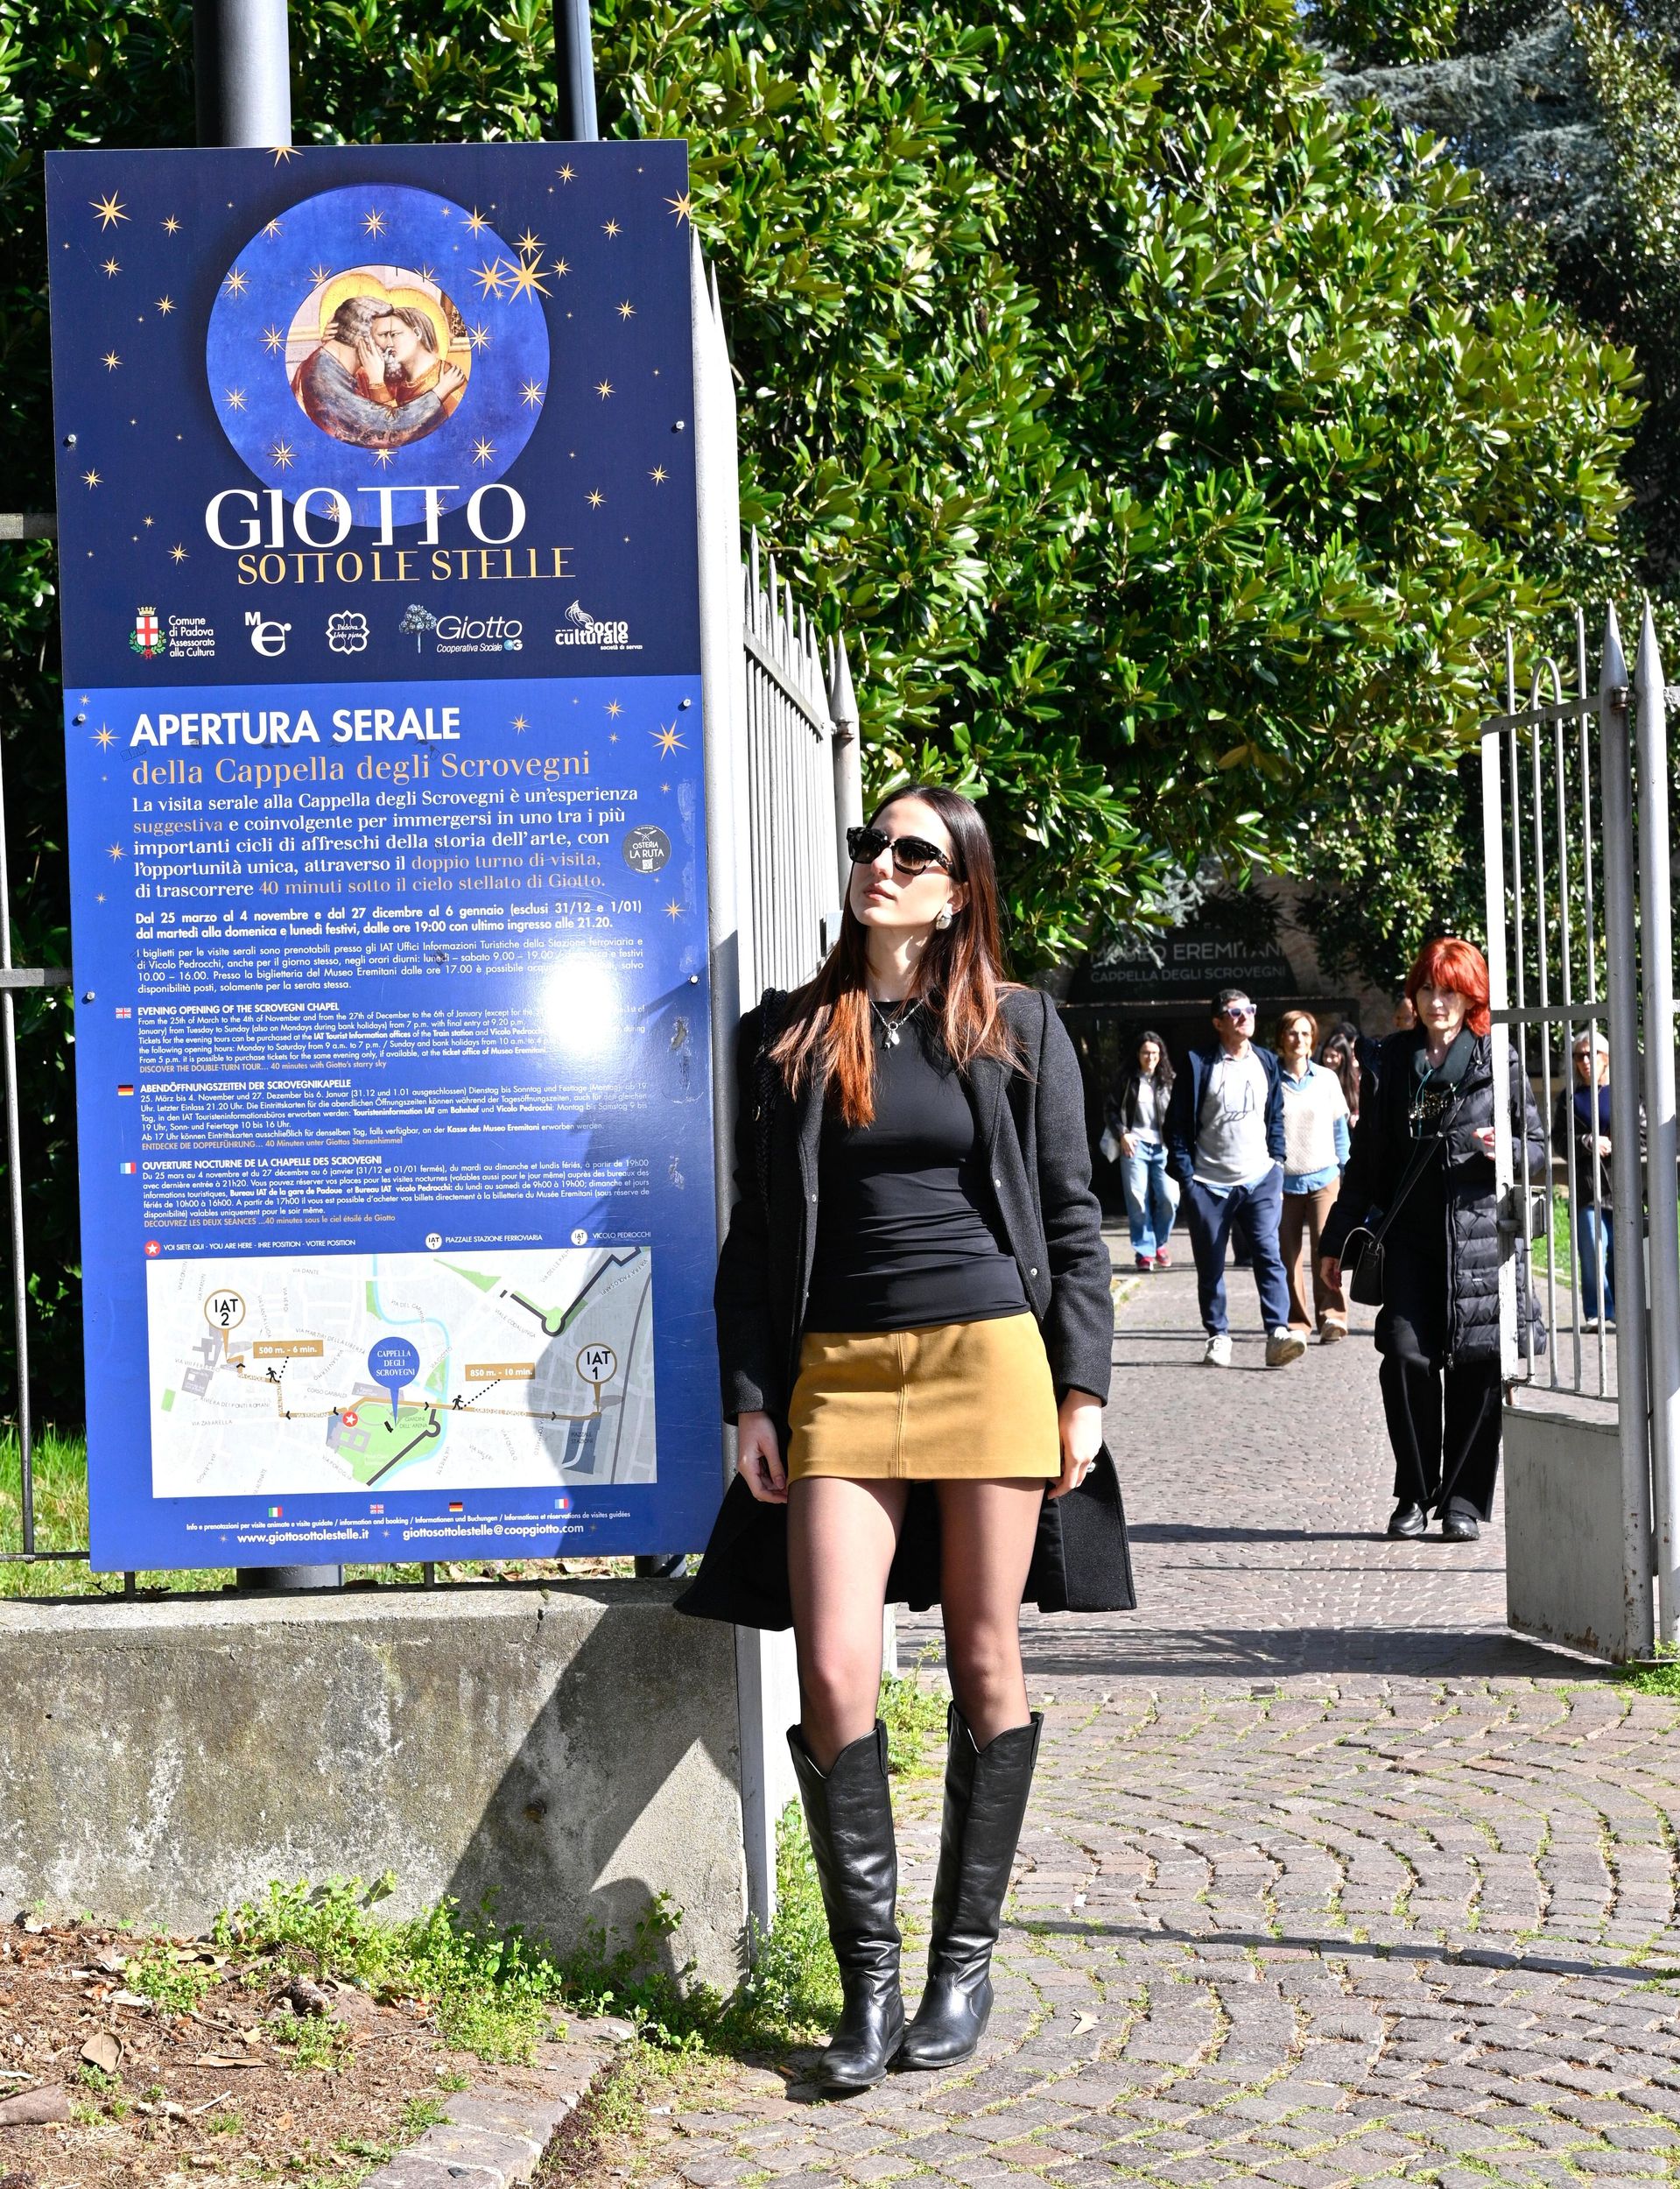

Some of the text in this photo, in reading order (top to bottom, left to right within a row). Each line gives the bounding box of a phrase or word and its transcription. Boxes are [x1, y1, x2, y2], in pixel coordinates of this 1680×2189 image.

[205, 483, 526, 550] GIOTTO
[237, 547, 576, 585] SOTTO LE STELLE
[168, 615, 206, 626] Comune
[436, 616, 523, 639] Giotto
[584, 621, 628, 634] socio
[169, 624, 214, 637] di Padova
[555, 628, 628, 645] culturale
[169, 637, 215, 647] Assessorato
[437, 643, 478, 654] Cooperativa
[479, 642, 503, 651] Sociale
[169, 646, 215, 658] alla Cultura
[130, 707, 460, 747] APERTURA SERALE
[132, 750, 589, 788] della Cappella degli Scrovegni
[133, 798, 152, 813] La
[158, 797, 202, 811] visita
[208, 795, 258, 810] serale
[264, 794, 292, 809] alla
[299, 792, 369, 811] Cappella
[376, 791, 416, 809] degli
[422, 789, 504, 807] Scrovegni
[510, 789, 520, 802] è
[134, 807, 625, 836] suggestiva e coinvolgente per immergersi in uno tra i più
[134, 839, 229, 858] importanti
[236, 838, 272, 853] cicli
[279, 837, 294, 851] di
[301, 835, 379, 851] affreschi
[386, 834, 427, 848] della
[434, 833, 485, 848] storia
[578, 833, 608, 844] con
[632, 841, 659, 849] OSTERIA
[629, 848, 664, 859] LA RUTA
[134, 853, 601, 880] l'opportunità unica, attraverso il doppio turno di visita,
[136, 874, 605, 897] di trascorrere 40 minuti sotto il cielo stellato di Giotto.
[136, 911, 154, 924] Dal
[160, 912, 175, 923] 25
[182, 914, 217, 923] marzo
[223, 910, 234, 922] al
[240, 911, 248, 921] 4
[254, 908, 308, 921] novembre
[327, 907, 345, 919] dal
[351, 907, 366, 919] 27
[372, 905, 423, 919] dicembre
[429, 904, 439, 917] al
[446, 905, 453, 917] 6
[460, 904, 504, 919] gennaio
[510, 902, 548, 917] (esclusi
[555, 901, 591, 915] 31/12
[597, 904, 605, 912] e
[611, 900, 642, 914] 1/01)
[136, 926, 153, 940] dal
[157, 926, 198, 939] martedì
[201, 926, 221, 938] alla
[224, 925, 277, 937] domenica
[290, 923, 322, 935] lunedì
[326, 922, 360, 935] festivi,
[363, 921, 390, 934] dalle
[392, 925, 411, 933] ore
[415, 920, 446, 932] 19:00
[471, 919, 504, 931] ultimo
[508, 919, 552, 933] ingresso
[555, 917, 574, 928] alle
[578, 917, 613, 928] 21.20.
[1091, 965, 1286, 983] CAPPELLA DEGLI SCROVEGNI
[137, 1006, 177, 1016] EVENING
[179, 1005, 220, 1015] OPENING
[236, 1004, 252, 1013] THE
[255, 1003, 305, 1012] SCROVEGNI
[307, 1003, 340, 1011] CHAPEL
[140, 1079, 351, 1093] ABENDÖFFNUNGSZEITEN DER SCROVEGNIKAPELLE
[142, 1160, 193, 1170] OUVERTURE
[194, 1159, 243, 1169] NOCTURNE
[257, 1158, 269, 1167] LA
[271, 1158, 311, 1167] CHAPELLE
[313, 1157, 329, 1165] DES
[331, 1156, 382, 1165] SCROVEGNI
[214, 1299, 238, 1313] IAT
[221, 1312, 229, 1327] 2
[258, 1346, 273, 1355] 500
[376, 1349, 411, 1358] CAPPELLA
[587, 1351, 610, 1365] IAT
[376, 1368, 416, 1377] SCROVEGNI
[592, 1366, 598, 1380] 1
[237, 1528, 369, 1545] www.giottosottolestelle.it
[403, 1524, 584, 1541] giottosottolestelle@coopgiotto.com
